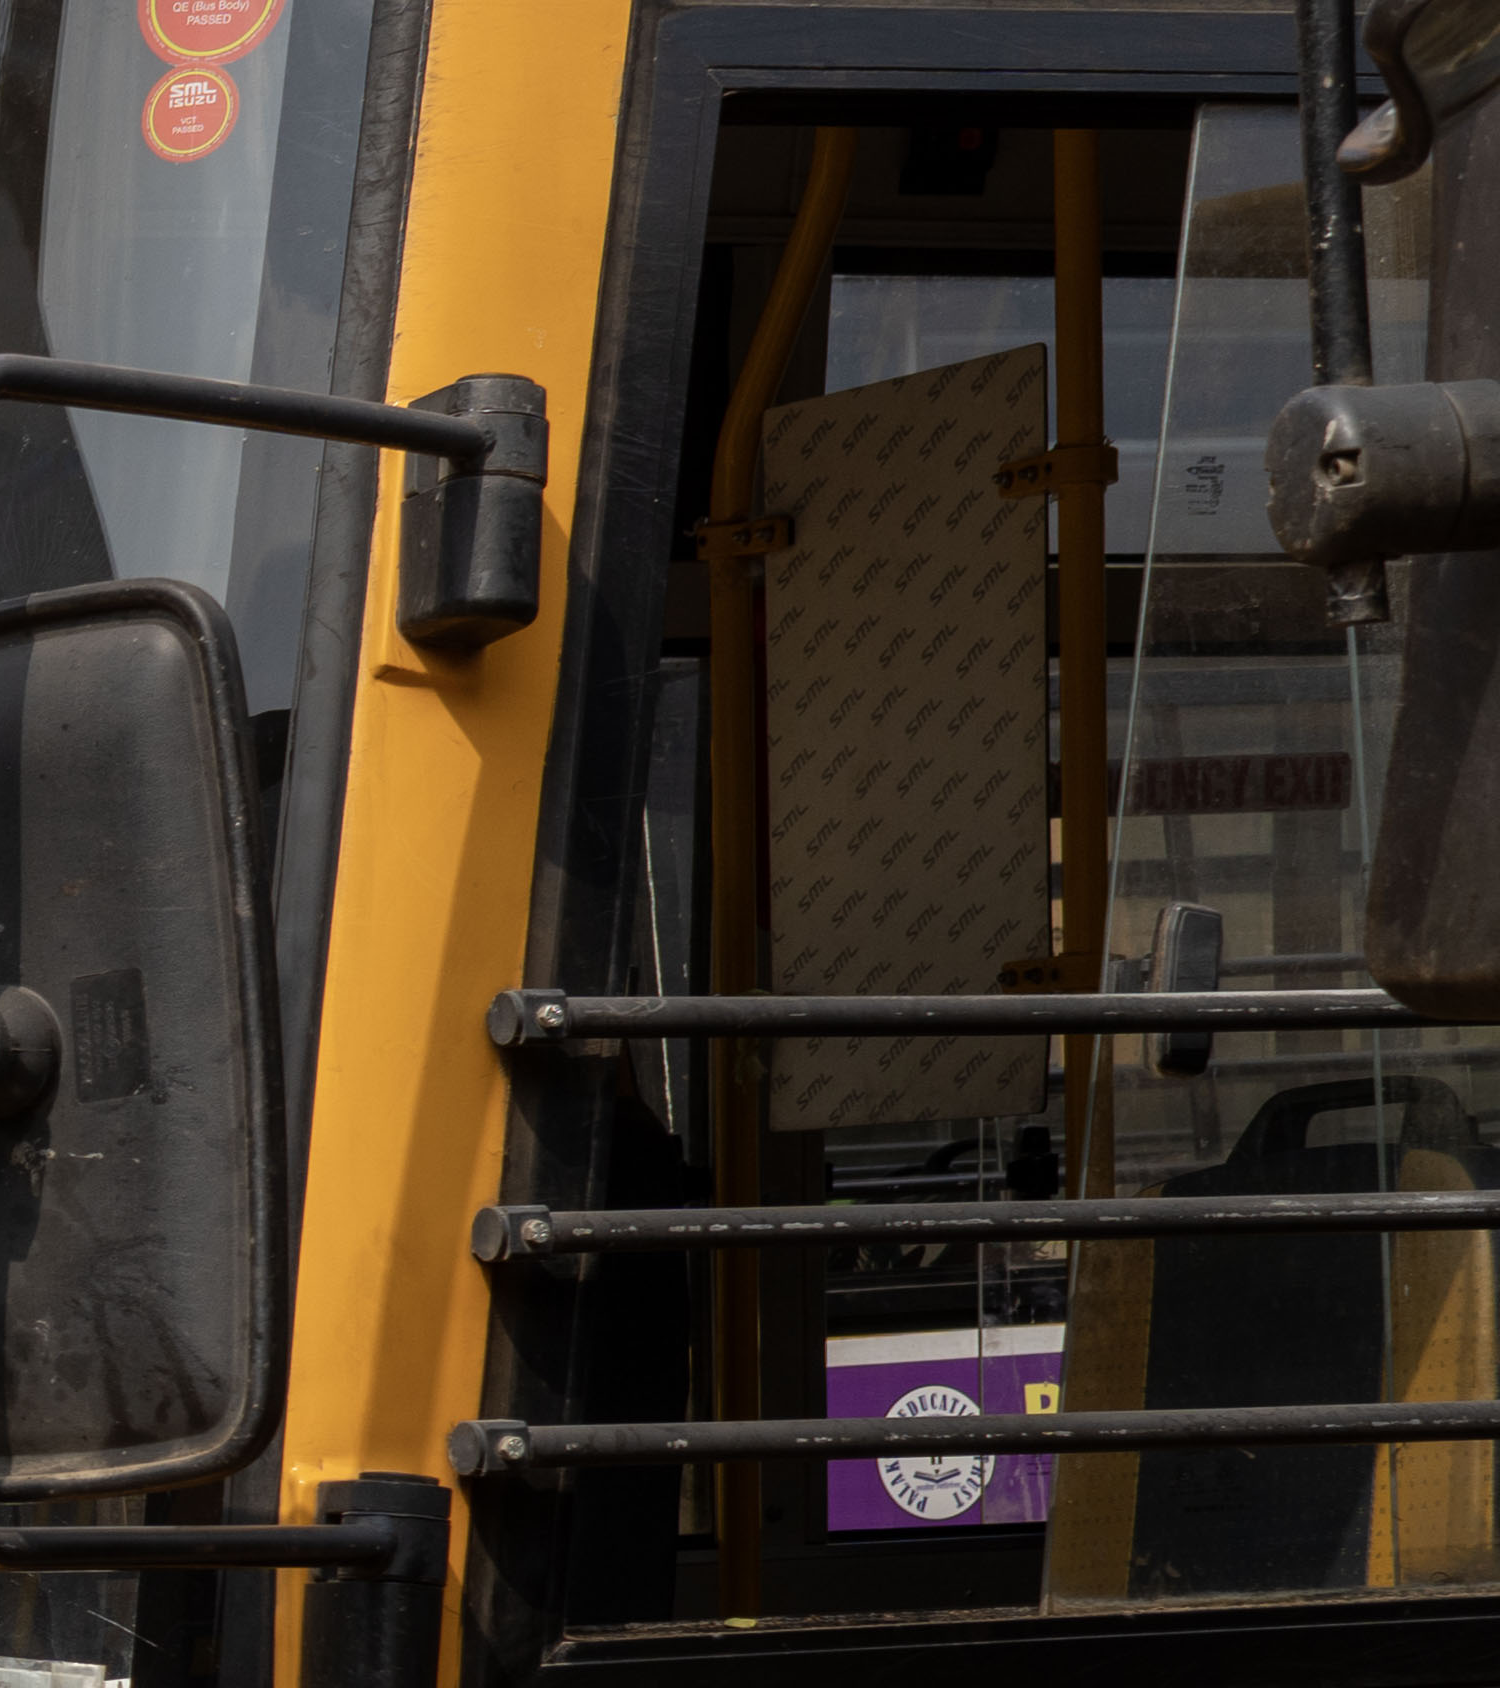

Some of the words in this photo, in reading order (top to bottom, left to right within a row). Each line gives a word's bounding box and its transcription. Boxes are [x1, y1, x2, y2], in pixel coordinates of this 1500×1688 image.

[186, 14, 232, 25] PASSED
[169, 81, 217, 98] SML
[172, 124, 204, 135] PASSED
